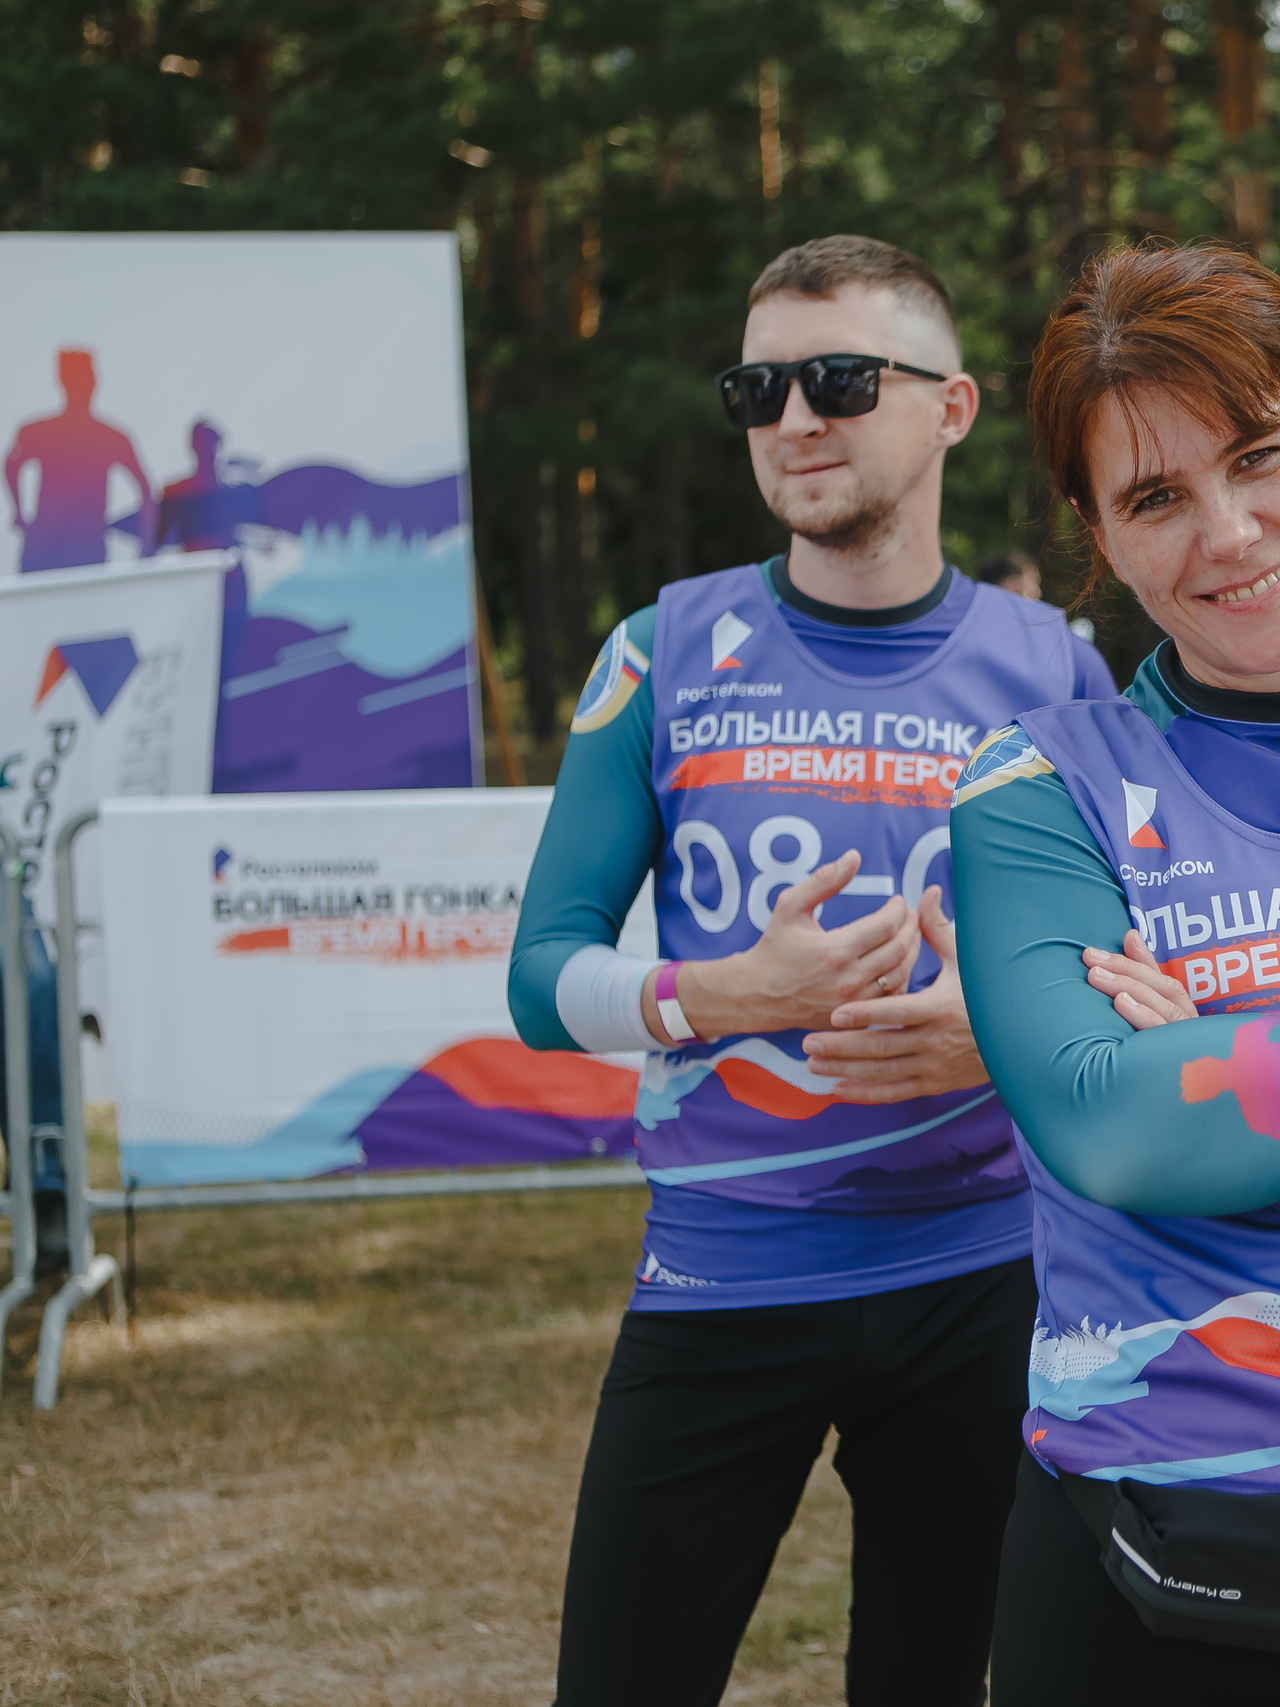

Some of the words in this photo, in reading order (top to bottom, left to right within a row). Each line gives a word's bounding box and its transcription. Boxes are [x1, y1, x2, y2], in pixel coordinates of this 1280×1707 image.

[676, 681, 783, 705] Ростелеком
[669, 709, 863, 753] БОЛЬШАЯ
[873, 712, 997, 758] ГОНК
[743, 750, 866, 782] ВРЕМЯ
[874, 753, 966, 792] ГЕРО
[212, 886, 393, 922] БОЛЬШАЯ
[403, 883, 519, 916] ГОНКА
[1163, 1576, 1218, 1597] Kalenji
